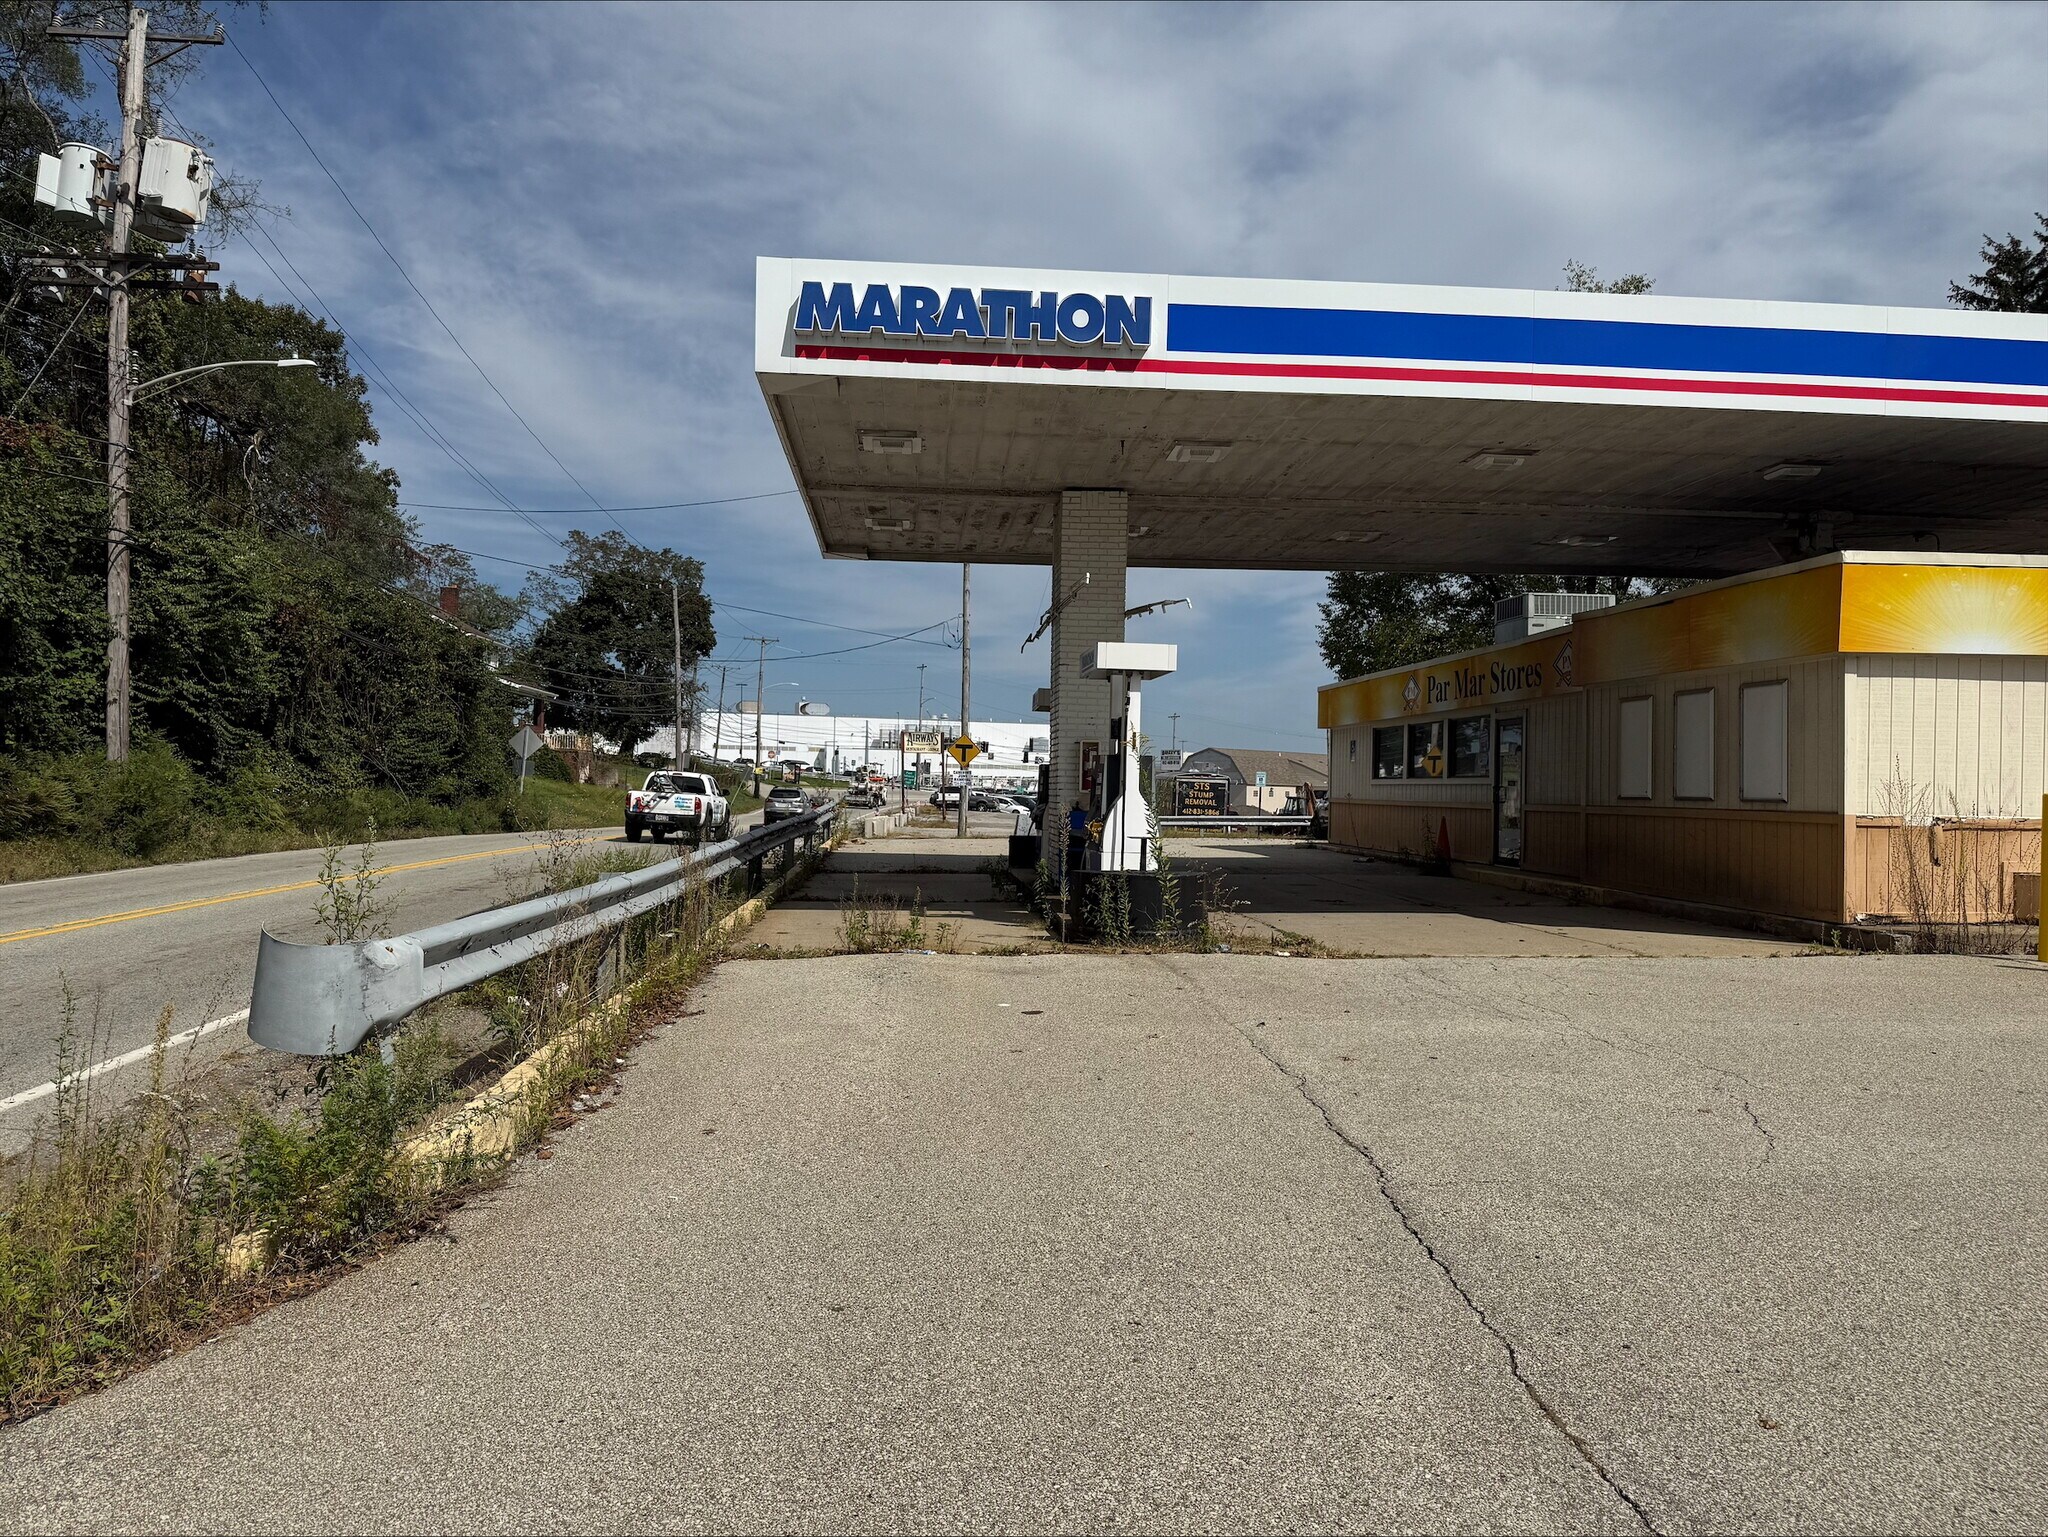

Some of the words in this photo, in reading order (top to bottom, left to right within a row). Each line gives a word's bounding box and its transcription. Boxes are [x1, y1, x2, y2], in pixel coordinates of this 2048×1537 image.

[794, 280, 1153, 348] MARATHON
[1427, 675, 1450, 704] Par
[1454, 667, 1485, 700] Mar
[1489, 661, 1542, 694] Stores
[906, 732, 939, 746] AIRWAYS
[1194, 782, 1210, 790] STS
